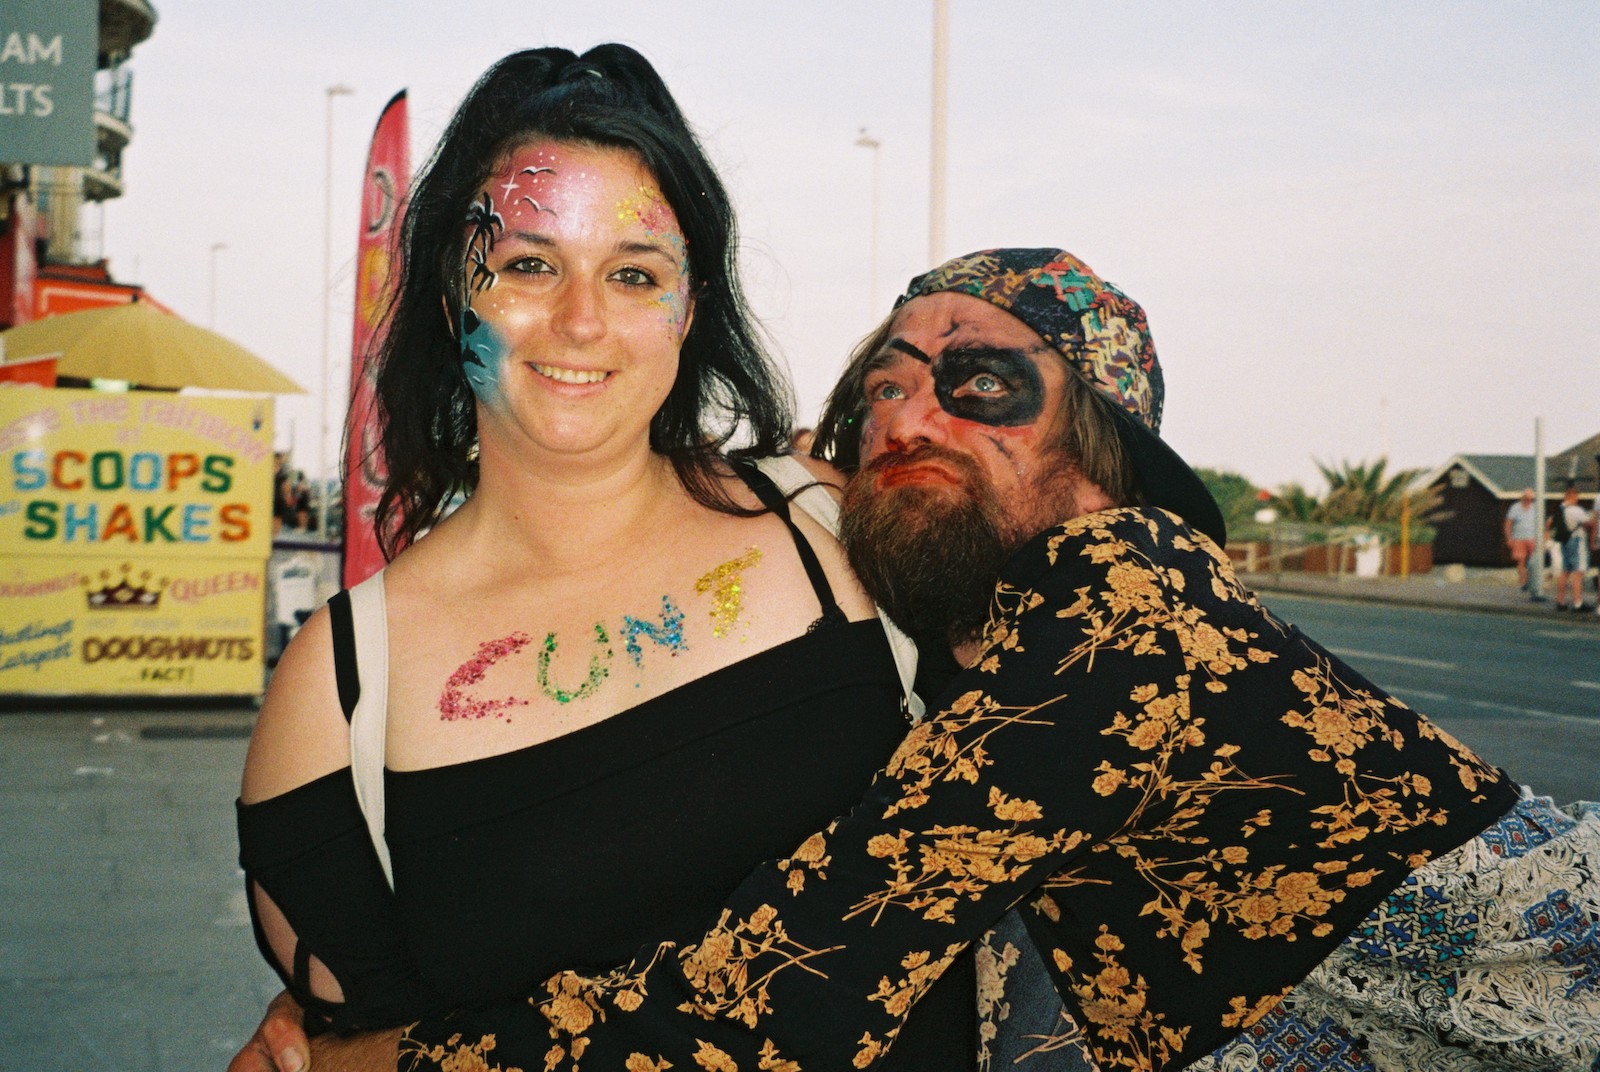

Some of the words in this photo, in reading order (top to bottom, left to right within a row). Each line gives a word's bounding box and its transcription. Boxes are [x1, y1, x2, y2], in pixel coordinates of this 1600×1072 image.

[12, 449, 236, 494] SCOOPS
[23, 499, 252, 543] SHAKES
[169, 570, 259, 606] QUEEN
[81, 635, 255, 664] DOUGHNUTS
[437, 546, 763, 722] CUNT
